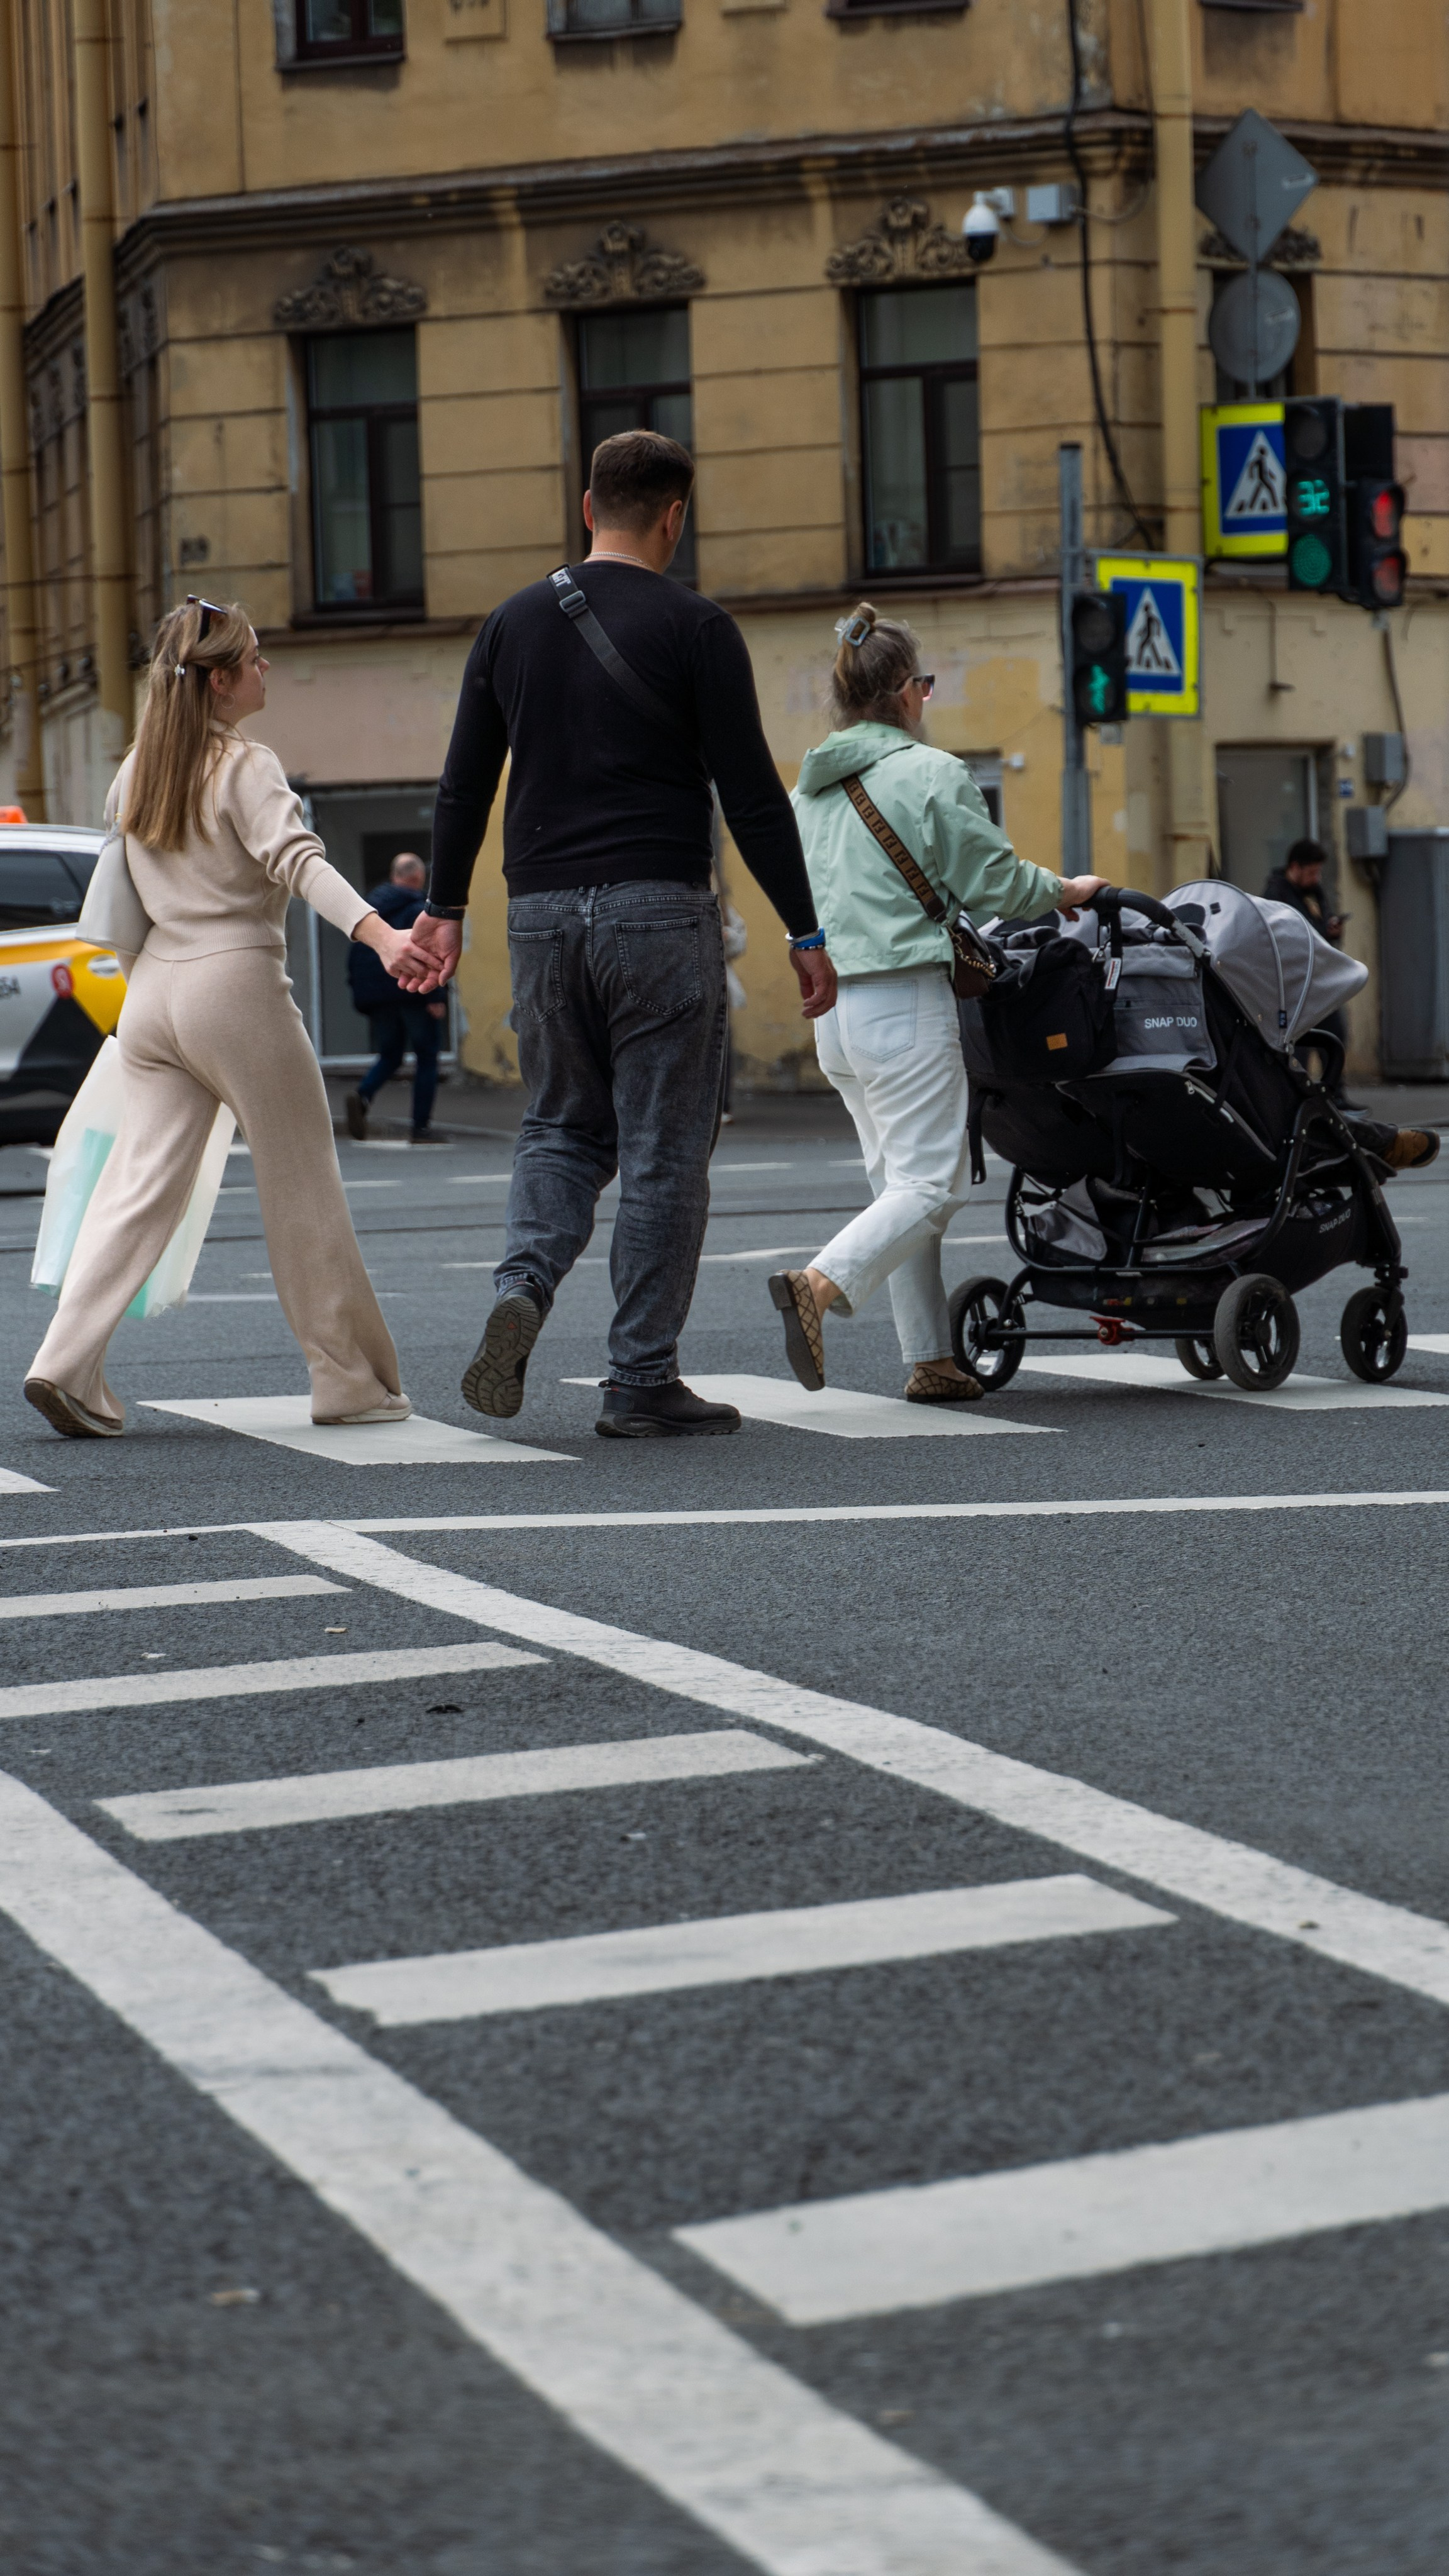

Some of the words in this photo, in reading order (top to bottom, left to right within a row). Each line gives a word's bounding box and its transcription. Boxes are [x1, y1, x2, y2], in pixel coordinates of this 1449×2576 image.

[1297, 479, 1330, 515] 32
[1145, 1017, 1174, 1029] SNAP
[1176, 1017, 1197, 1027] DUO
[1319, 1218, 1338, 1233] SNAP
[1338, 1208, 1351, 1224] DUO
